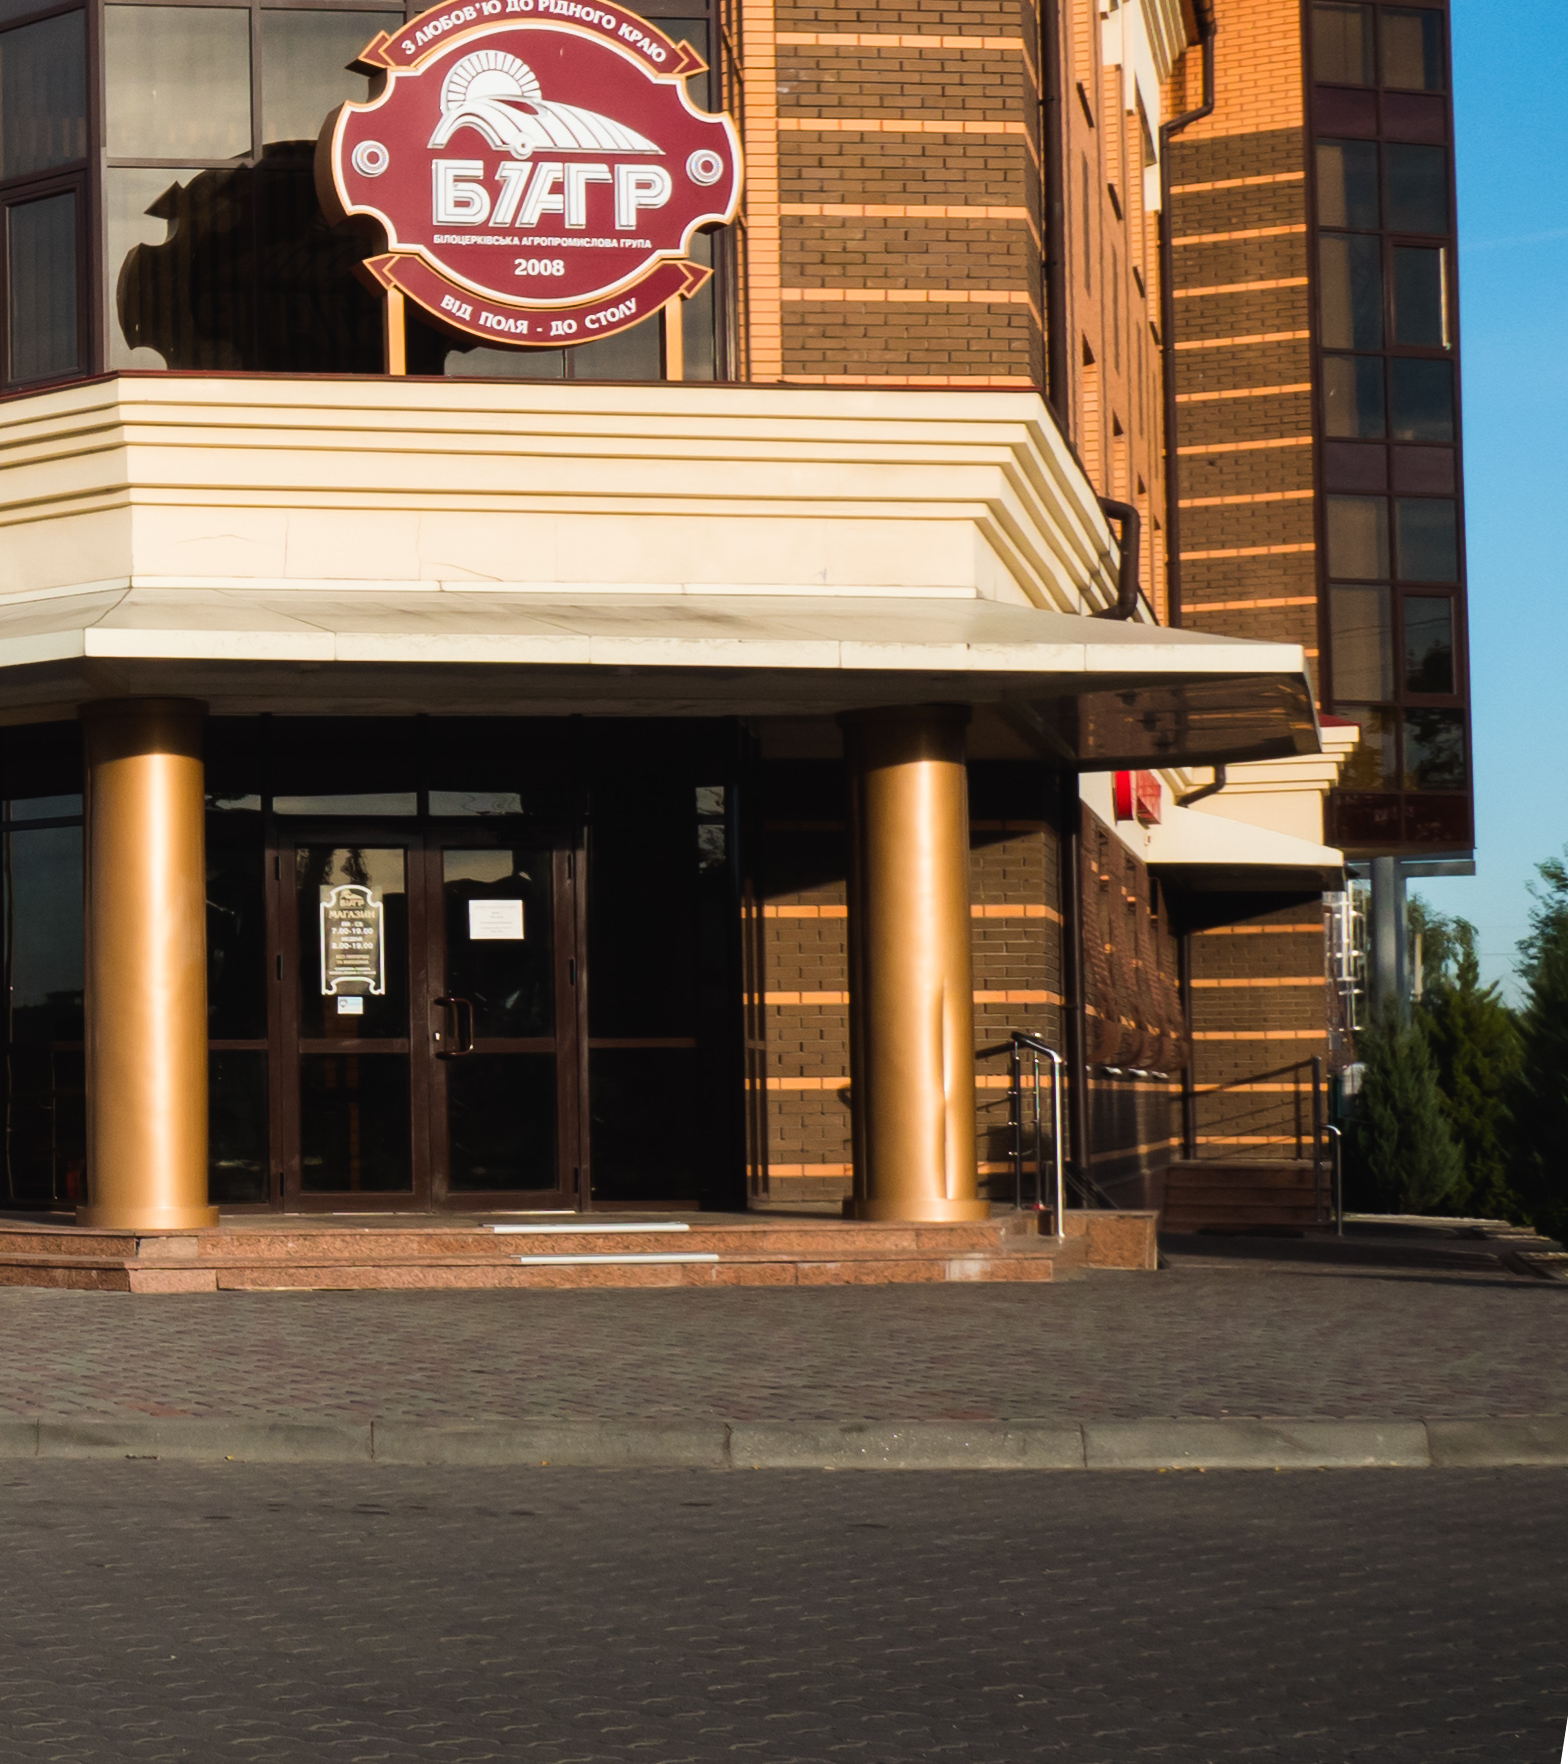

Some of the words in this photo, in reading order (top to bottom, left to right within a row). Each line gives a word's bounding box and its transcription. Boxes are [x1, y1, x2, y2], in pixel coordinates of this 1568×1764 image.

[401, 39, 416, 55] З
[415, 0, 502, 46] ЛЮБОВ'Ю
[617, 22, 667, 62] КРАЮ
[433, 234, 521, 246] БІЛОЦЕРКІВСЬКА
[521, 236, 618, 248] АГРОПРОМИСЛОВА
[619, 239, 653, 249] ГРУПА
[514, 258, 565, 276] 2008
[440, 294, 474, 321] ВІД
[478, 311, 529, 335] ПОЛЯ
[549, 319, 578, 337] ДО
[584, 297, 638, 330] СТОЛУ
[328, 909, 376, 919] МАГАЗИН
